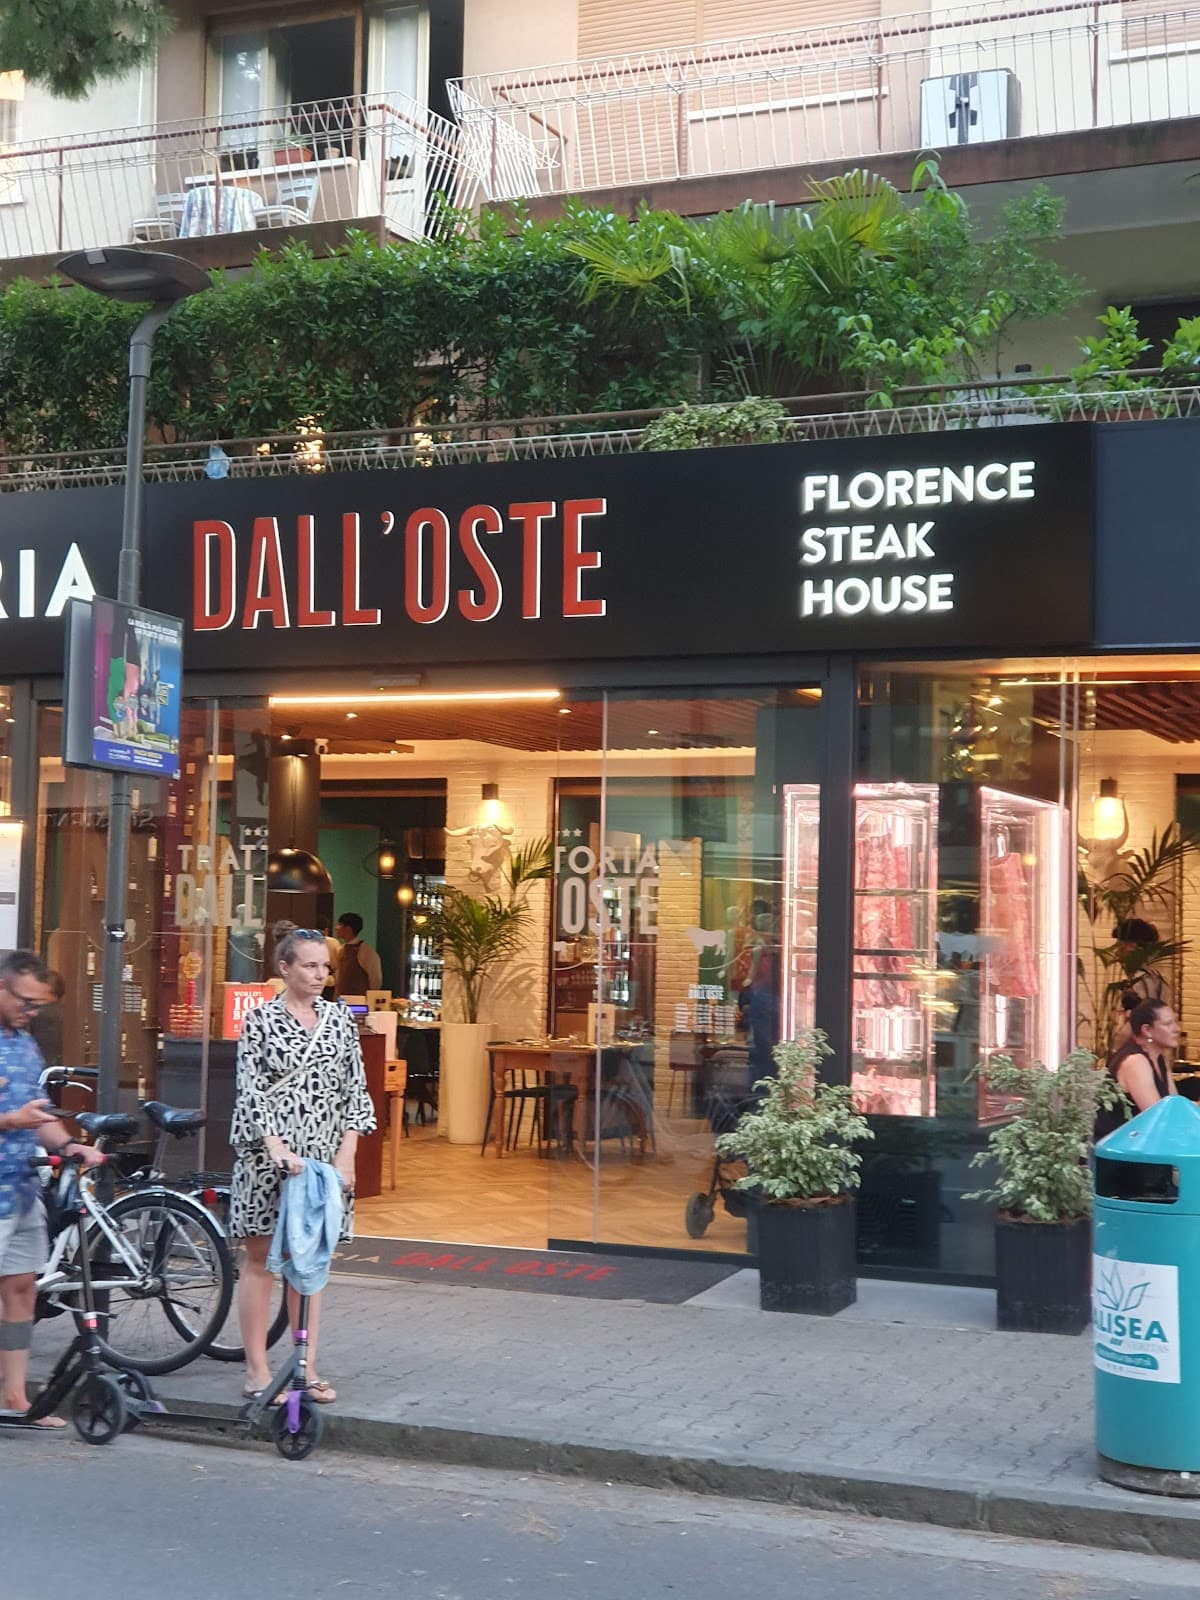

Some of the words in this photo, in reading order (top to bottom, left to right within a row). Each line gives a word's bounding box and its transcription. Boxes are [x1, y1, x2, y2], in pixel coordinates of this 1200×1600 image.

[801, 461, 1035, 513] FLORENCE
[0, 542, 96, 619] IA
[193, 498, 607, 631] DALL'OSTE
[801, 521, 935, 564] STEAK
[801, 573, 954, 616] HOUSE
